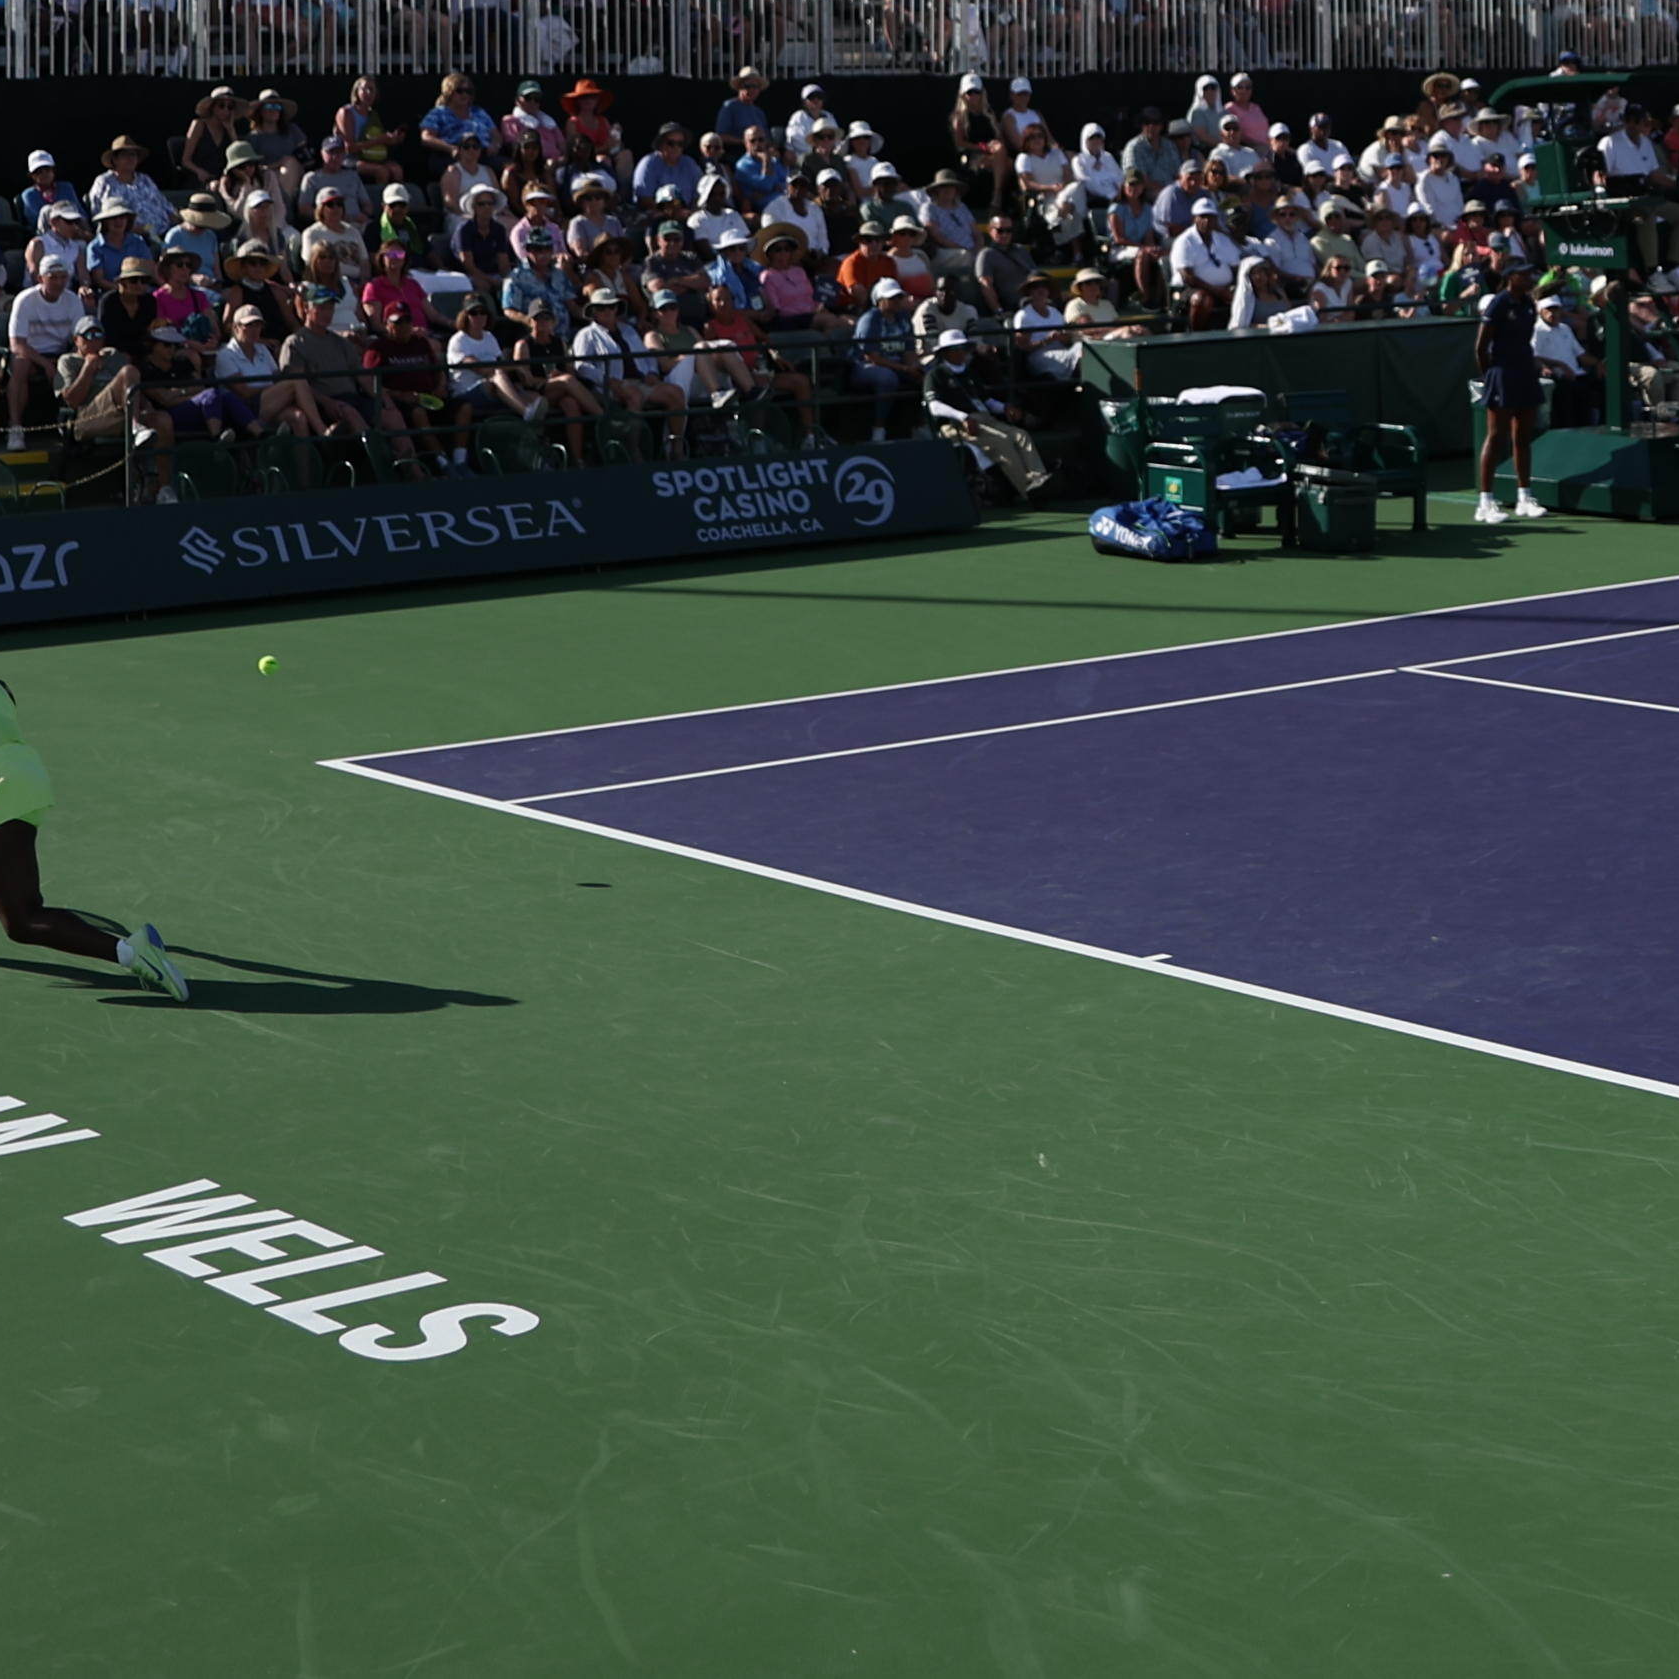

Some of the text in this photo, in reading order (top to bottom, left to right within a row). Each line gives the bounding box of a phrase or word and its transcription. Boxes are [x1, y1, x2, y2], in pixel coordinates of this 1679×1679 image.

[1569, 243, 1614, 257] lululemon
[652, 458, 829, 498] SPOTLIGHT
[693, 489, 811, 522] CASINO
[234, 497, 587, 568] SILVERSEA
[799, 517, 824, 533] CA
[62, 1178, 540, 1362] WELLS
